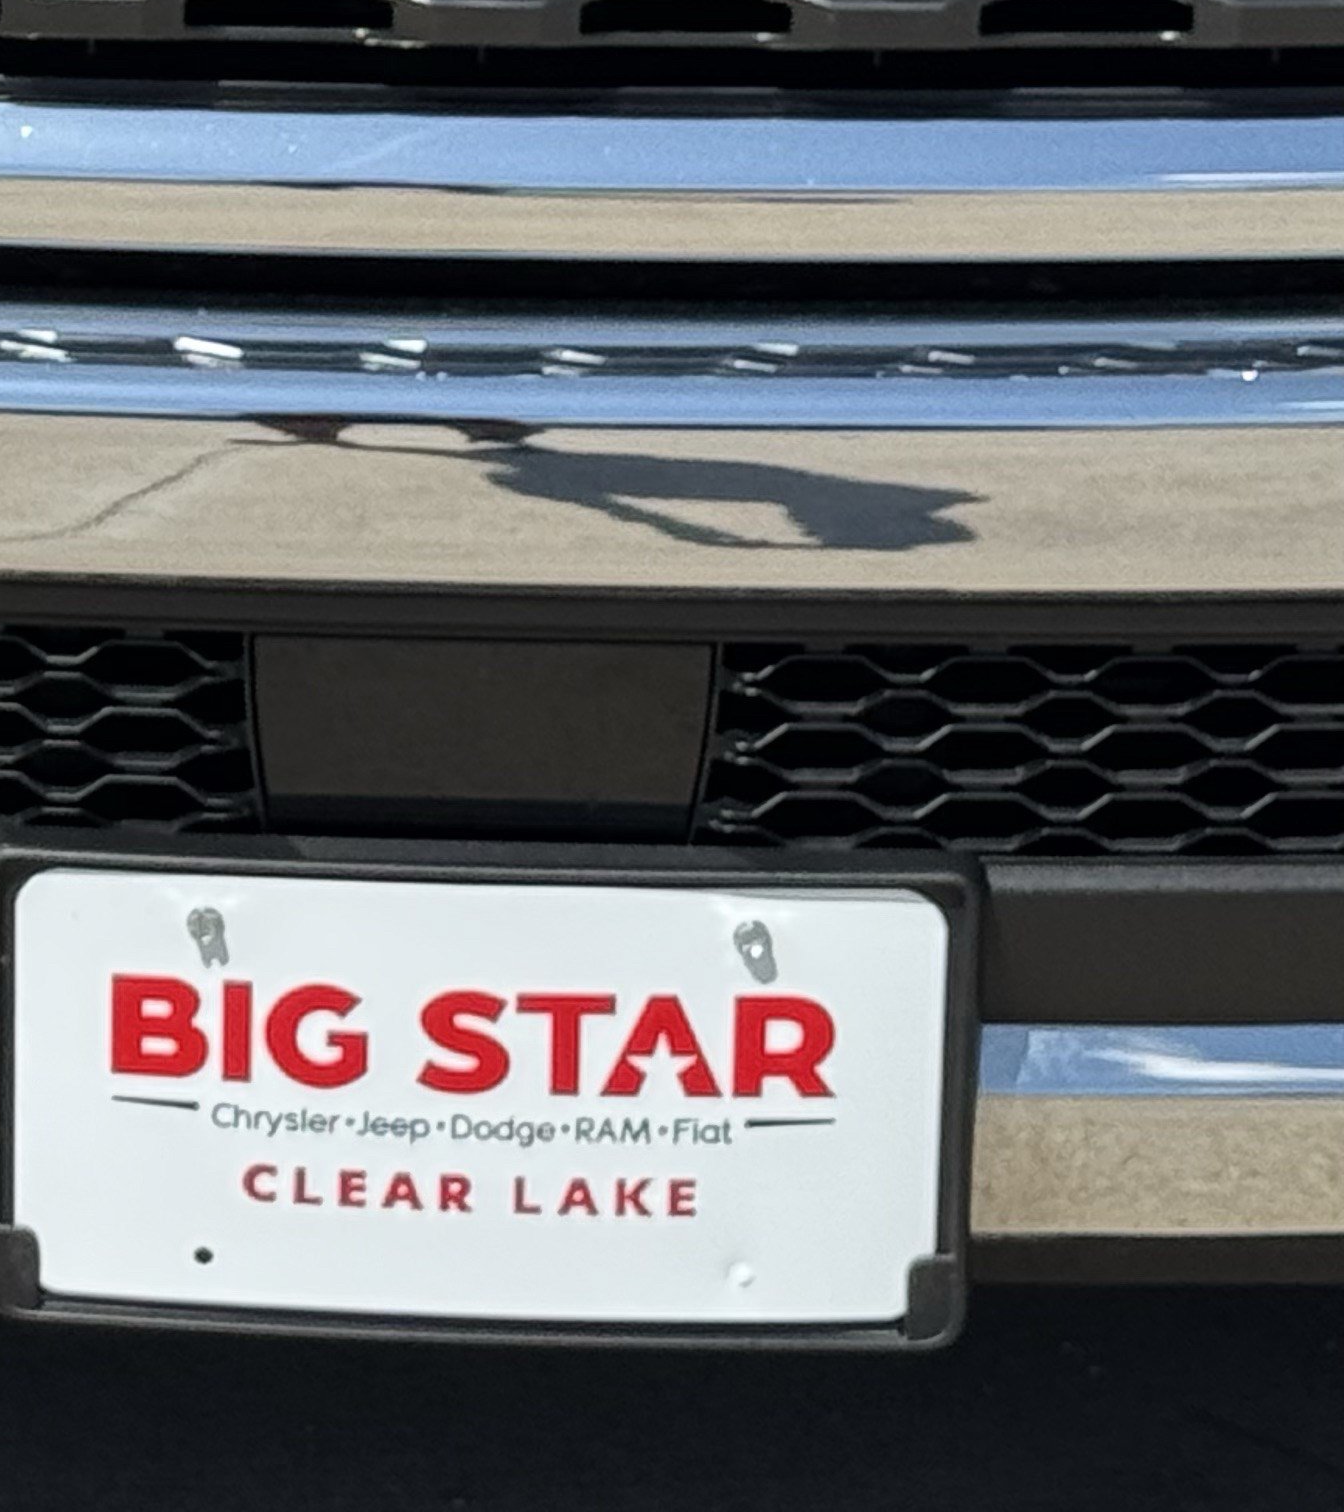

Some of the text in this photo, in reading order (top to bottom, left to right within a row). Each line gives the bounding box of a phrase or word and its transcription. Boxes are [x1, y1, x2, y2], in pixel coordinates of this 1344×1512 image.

[109, 972, 837, 1099] BIG STAR
[241, 1163, 700, 1218] CLEAR LAKE
